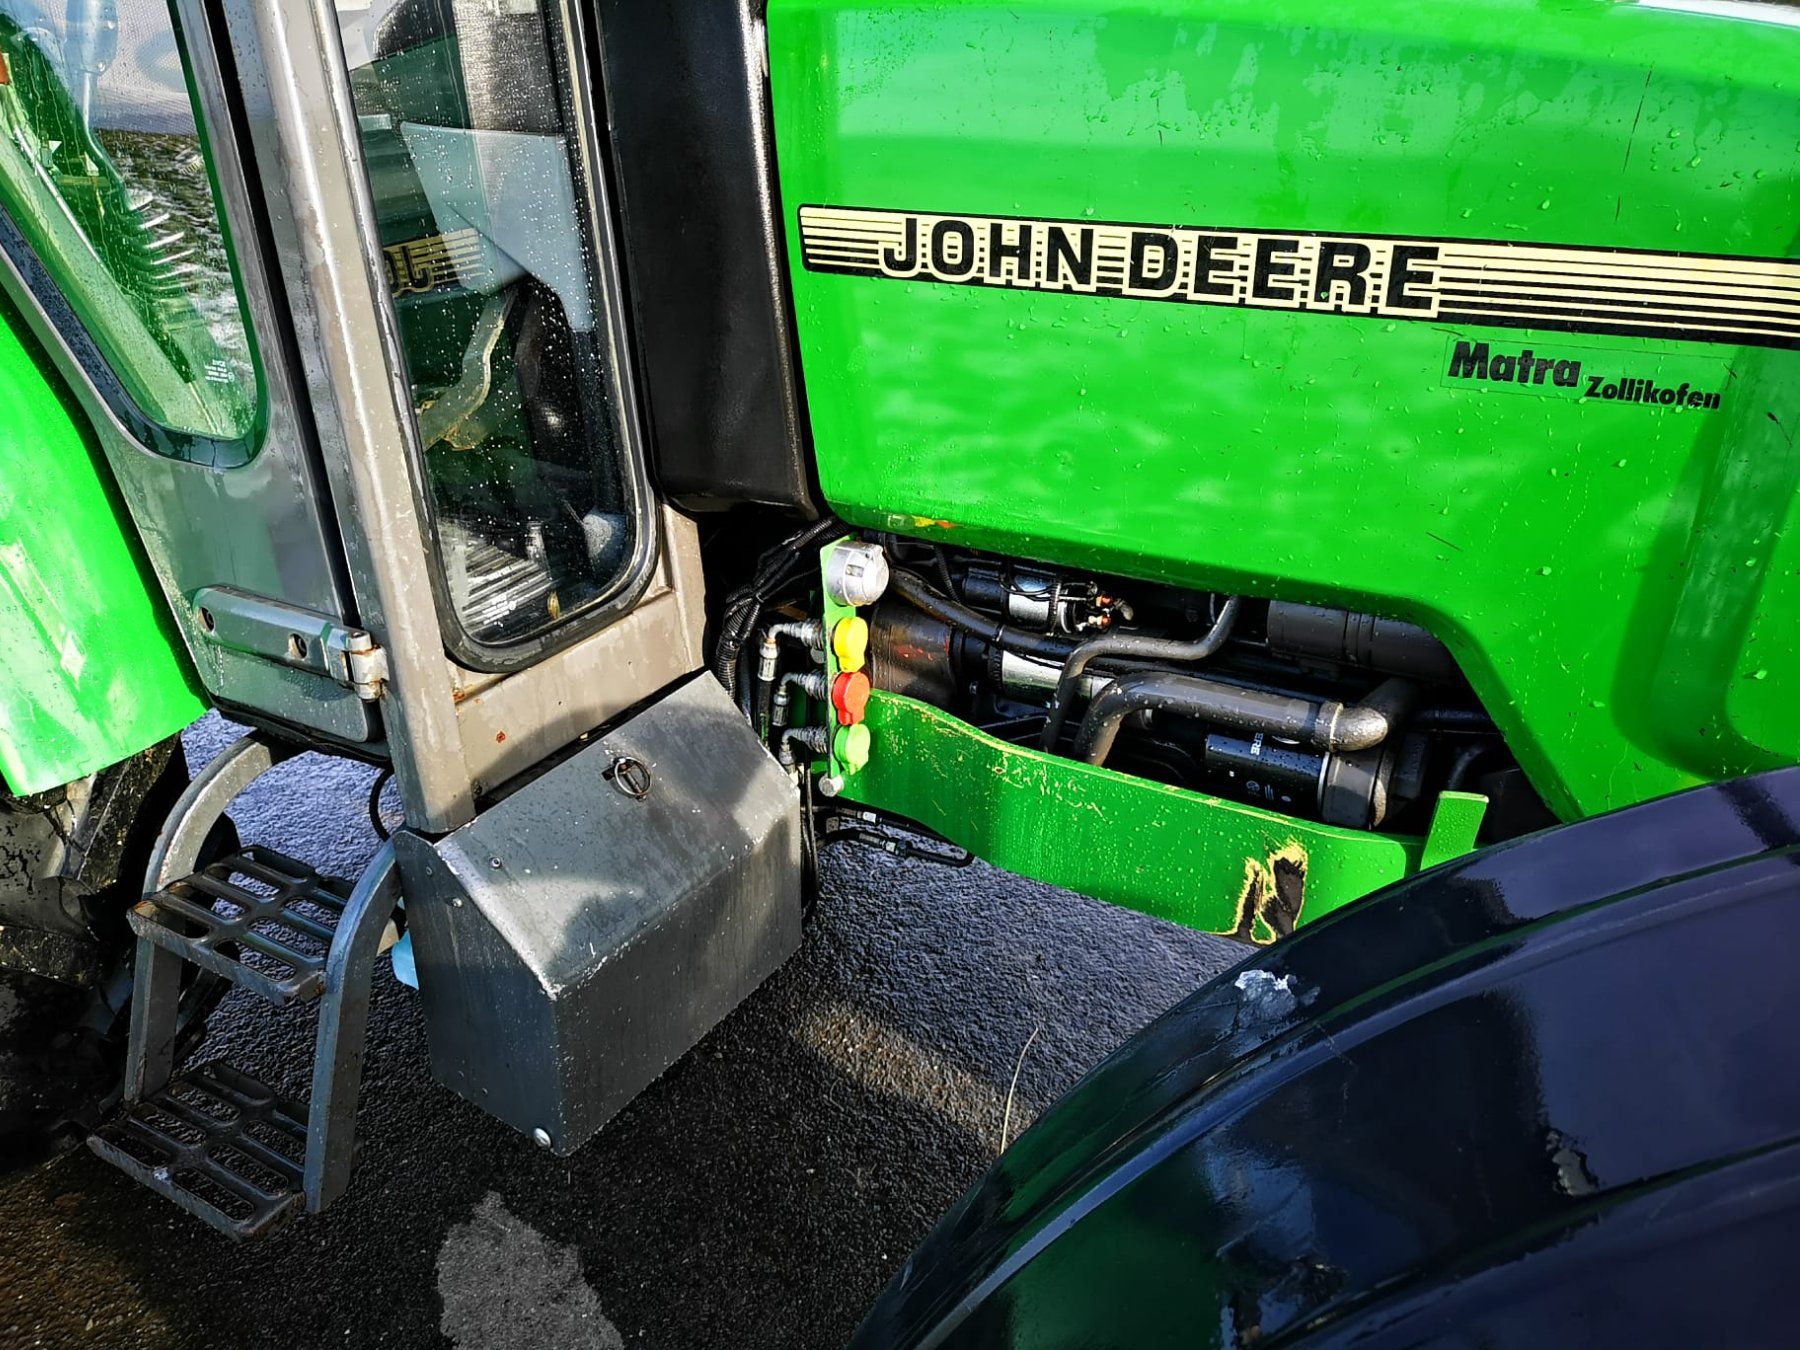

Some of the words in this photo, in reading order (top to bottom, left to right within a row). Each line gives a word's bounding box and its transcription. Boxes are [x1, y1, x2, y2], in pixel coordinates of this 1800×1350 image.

[881, 216, 1096, 288] JOHN
[1126, 230, 1440, 315] DEERE
[1448, 341, 1582, 387] Matra
[1583, 375, 1721, 410] Zollikofen
